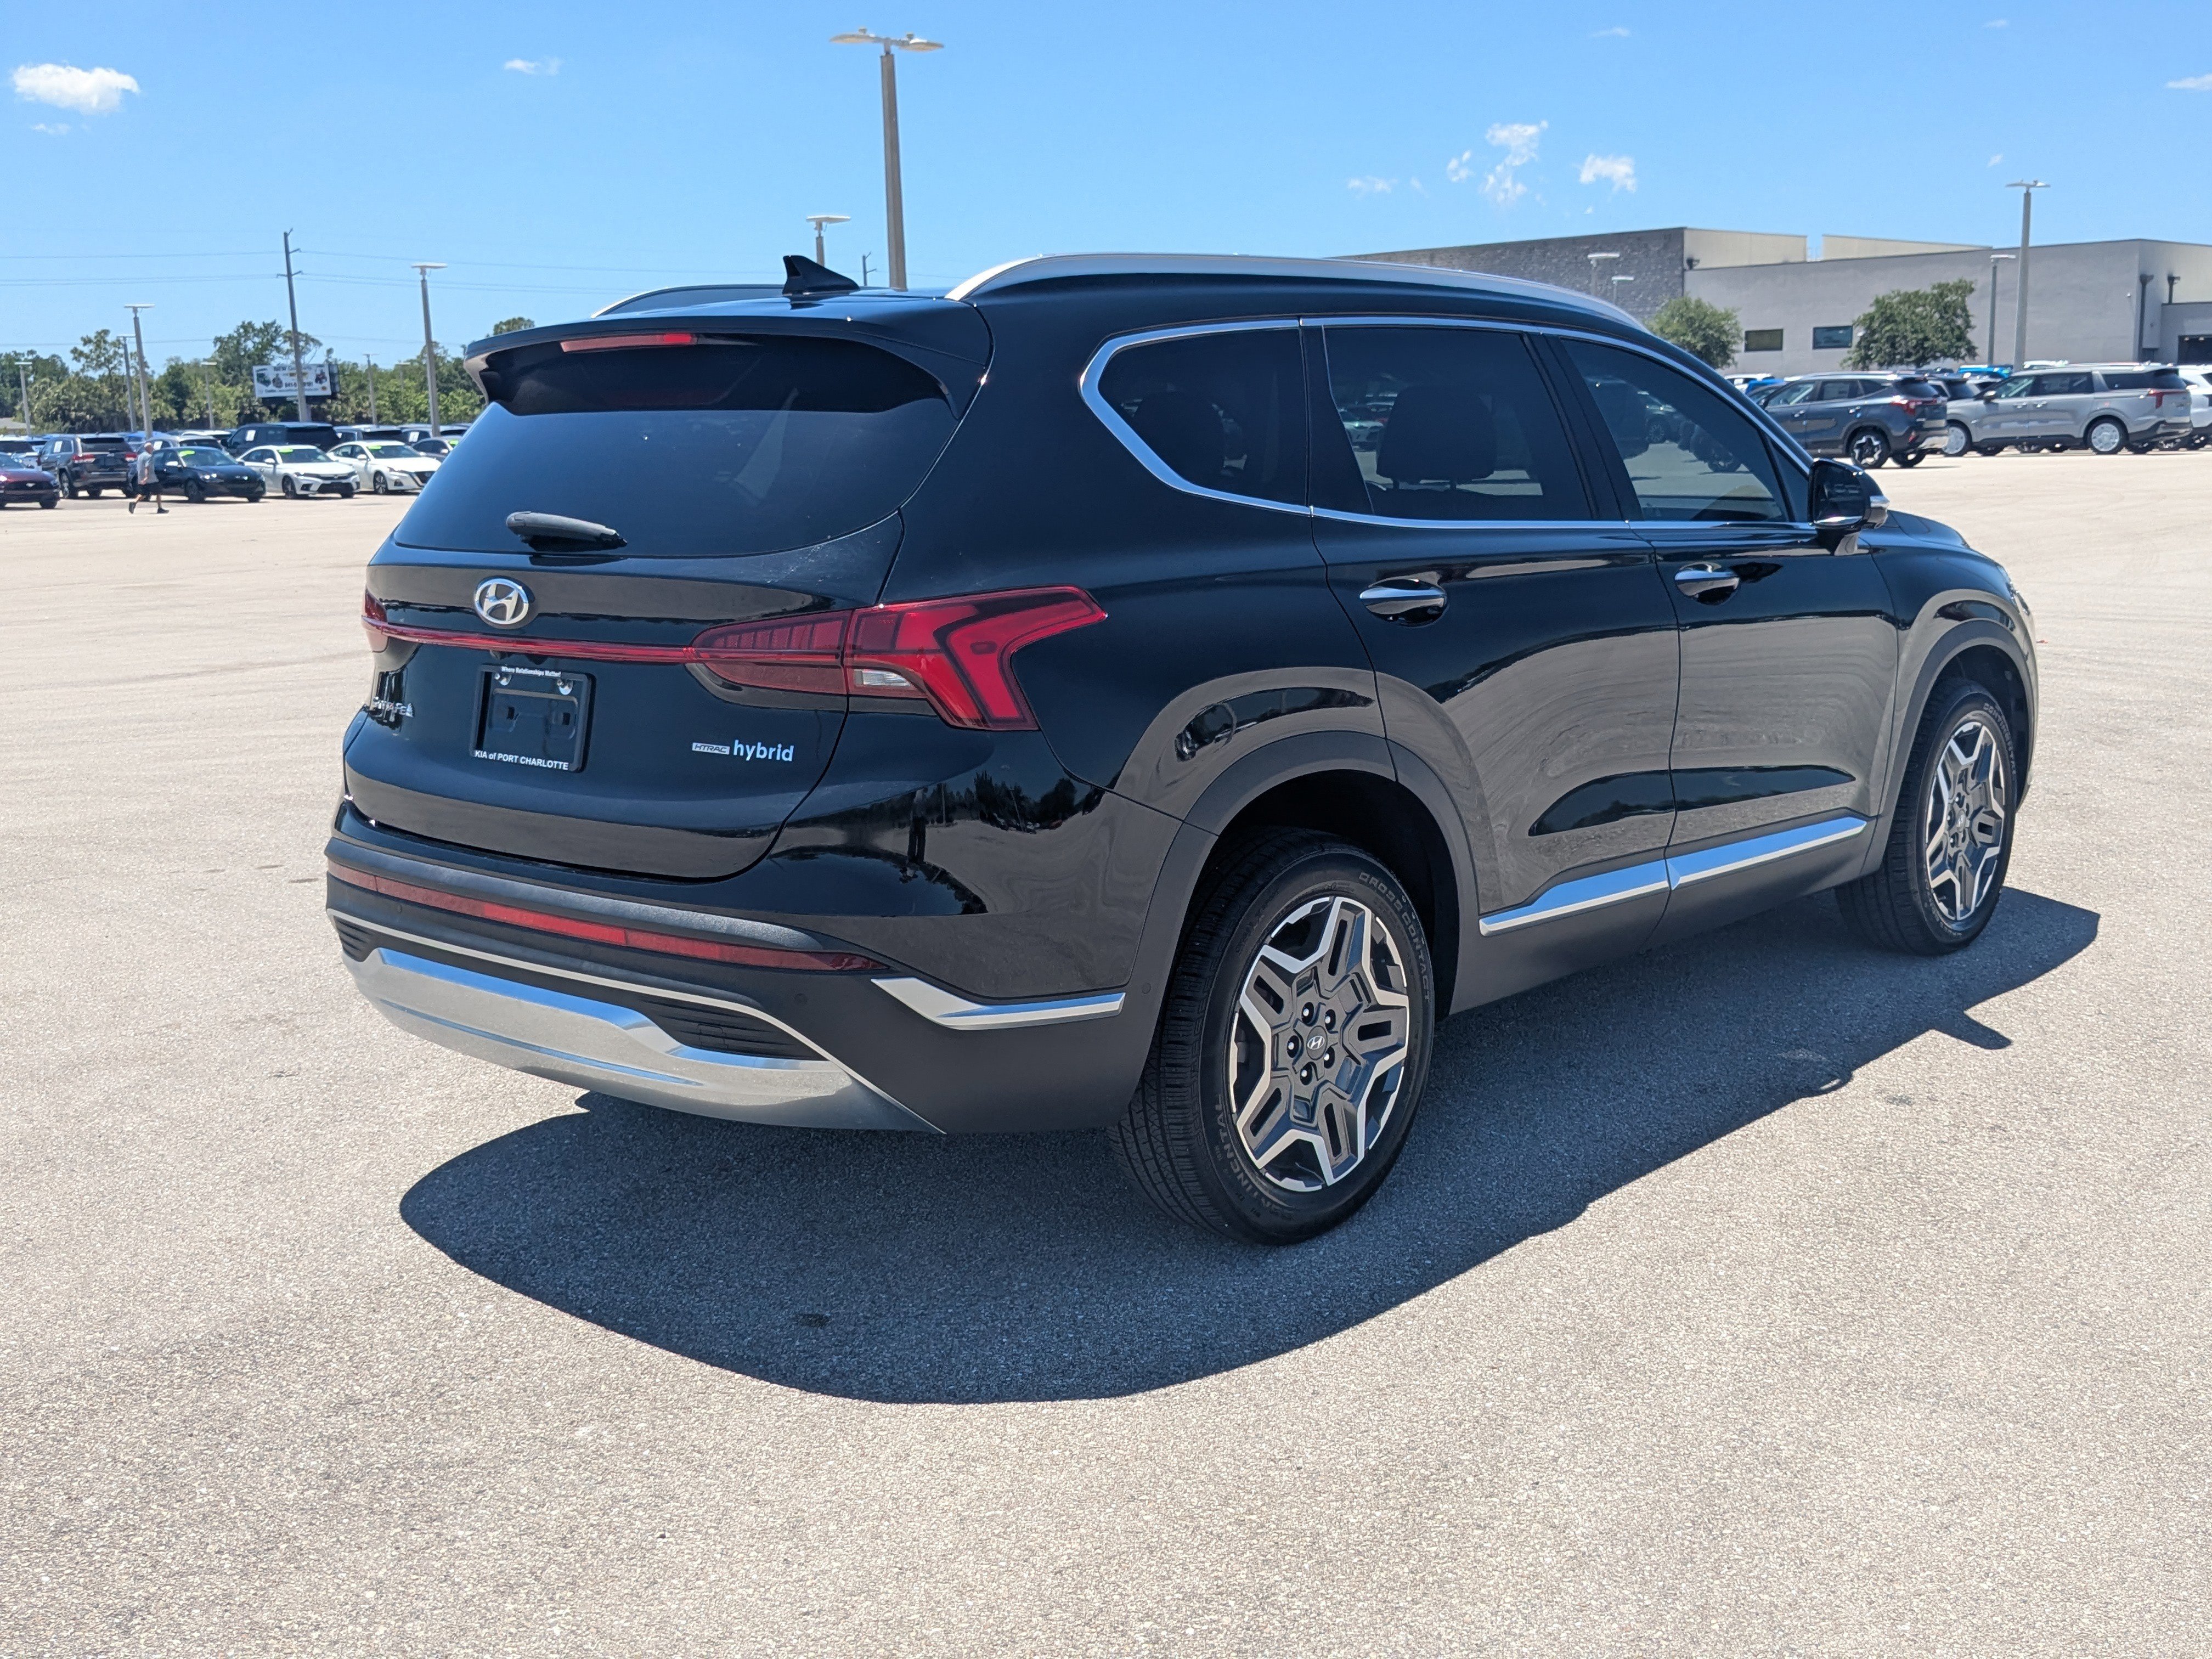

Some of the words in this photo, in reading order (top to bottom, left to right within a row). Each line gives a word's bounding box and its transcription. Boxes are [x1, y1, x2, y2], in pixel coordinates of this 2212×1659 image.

[475, 750, 488, 759] KIA
[488, 752, 496, 760] of
[498, 753, 519, 763] PORT
[520, 756, 569, 770] CHARLOTTE
[693, 743, 729, 754] HTRAC
[733, 740, 794, 762] hybrid
